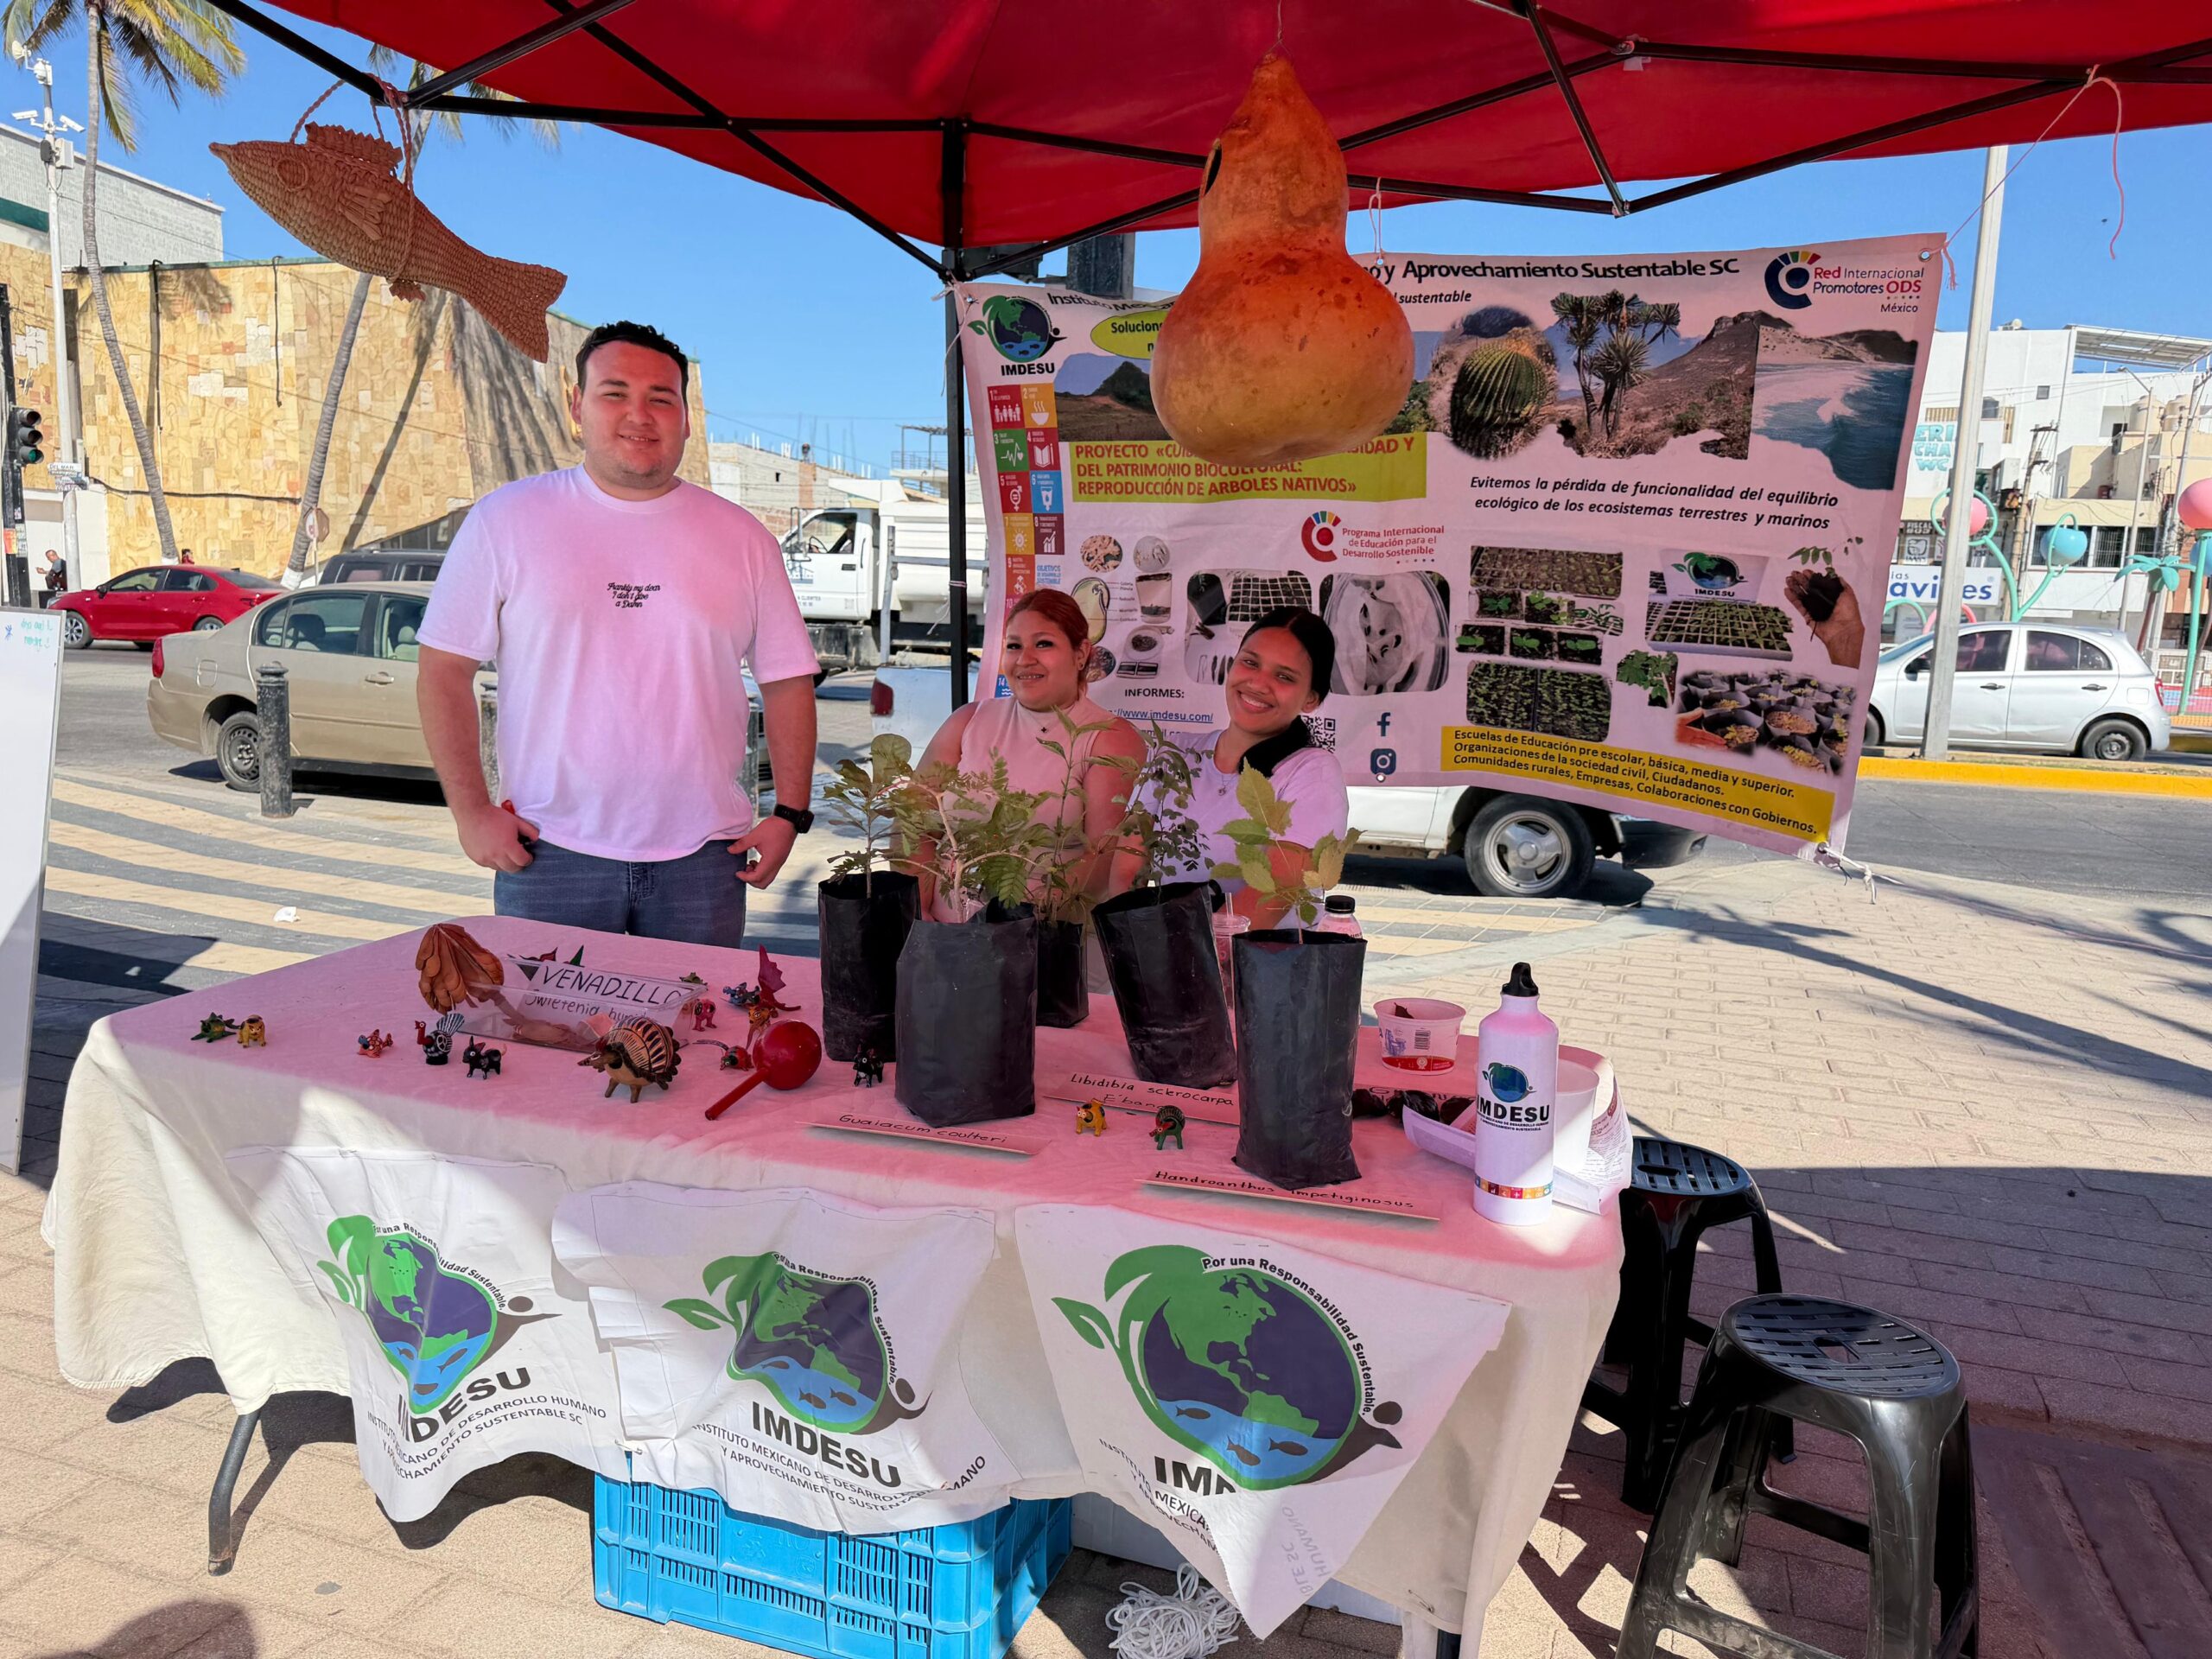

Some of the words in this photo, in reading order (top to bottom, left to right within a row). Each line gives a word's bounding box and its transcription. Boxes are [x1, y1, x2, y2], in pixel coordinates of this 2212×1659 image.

[1384, 264, 1395, 284] y
[1402, 260, 1579, 283] Aprovechamiento
[1581, 259, 1707, 278] Sustentable
[1709, 257, 1740, 276] SC
[1814, 266, 1841, 279] Red
[1844, 267, 1925, 279] Internacional
[1399, 289, 1472, 304] sustentable
[1813, 281, 1884, 295] Promotores
[1886, 279, 1923, 294] ODS
[1046, 293, 1113, 310] Instituto
[1880, 302, 1918, 314] México
[1001, 362, 1056, 377] IMDESU
[1076, 443, 1149, 459] PROYECTO
[1403, 436, 1415, 452] Y
[1077, 463, 1103, 477] DEL
[1106, 463, 1192, 477] PATRIMONIO
[1077, 479, 1184, 496] REPRODUCCIÓN
[1186, 482, 1205, 496] DE
[1207, 477, 1278, 496] ARBOLES
[1282, 477, 1357, 493] NATIVOS»
[1470, 476, 1530, 489] Evitemos
[1535, 477, 1548, 490] la
[1552, 478, 1606, 493] pérdida
[1611, 480, 1629, 493] de
[1630, 480, 1735, 499] funcionalidad
[1739, 487, 1764, 501] del
[1767, 491, 1839, 507] equilibrio
[1475, 496, 1539, 512] ecológico
[1543, 498, 1560, 512] de
[1564, 499, 1584, 512] los
[1588, 501, 1674, 517] ecosistemas
[1679, 505, 1748, 523] terrestres
[1754, 512, 1764, 526] y
[1767, 513, 1830, 530] marinos
[1342, 528, 1381, 539] Programa
[1383, 524, 1445, 537] Internacional
[1348, 538, 1359, 547] de
[1360, 537, 1404, 549] Educación
[1405, 537, 1426, 548] para
[1427, 536, 1437, 544] el
[1342, 548, 1384, 559] Desarrollo
[1385, 545, 1434, 558] Sostenible
[1694, 588, 1736, 597] IMDESU
[1124, 688, 1185, 699] INFORMES:
[1108, 709, 1214, 724] ://www.imdesu.com/
[1453, 730, 1502, 742] Escuelas
[1504, 733, 1518, 744] de
[1521, 734, 1577, 753] Educación
[1579, 746, 1599, 757] pre
[1601, 749, 1646, 767] escolar,
[1648, 756, 1688, 776] básica,
[1691, 766, 1729, 782] media
[1731, 773, 1739, 785] y
[1741, 776, 1795, 798] superior.
[1453, 742, 1541, 760] Organizaciones
[1541, 750, 1555, 762] de
[1557, 753, 1567, 765] la
[1569, 755, 1619, 775] sociedad
[1621, 765, 1649, 781] civil,
[1651, 771, 1725, 796] Ciudadanos.
[1453, 753, 1529, 771] Comunidades
[1531, 762, 1574, 780] rurales,
[1576, 770, 1634, 792] Empresas,
[1637, 781, 1727, 811] Colaboraciones
[1728, 803, 1750, 817] con
[1751, 807, 1818, 835] Gobiernos.
[1147, 1085, 1235, 1106] sclerocarpa
[1477, 1094, 1550, 1123] IMDESU
[839, 1114, 931, 1133] Guaiacum
[937, 1129, 1007, 1143] coulteri
[1155, 1170, 1275, 1192] Handroanthus
[798, 1264, 879, 1313] Responsabilidad
[874, 1315, 898, 1386] Sustentable.
[1201, 1256, 1226, 1270] Por
[1230, 1256, 1255, 1267] una
[1259, 1258, 1358, 1342] Responsabilidad
[1352, 1342, 1376, 1416] Sustentable.
[441, 1427, 456, 1447] DE
[457, 1395, 548, 1429] DESARROLLO
[550, 1395, 607, 1419] HUMANO
[474, 1408, 567, 1433] SUSTENTABLE
[569, 1413, 583, 1426] SC
[691, 1423, 749, 1449] INSTITUTO
[752, 1441, 811, 1478] MEXICANO
[814, 1470, 831, 1484] DE
[752, 1401, 902, 1488] IMDESU
[721, 1445, 728, 1457] Y
[730, 1450, 846, 1502] APROVECHAMIENTO
